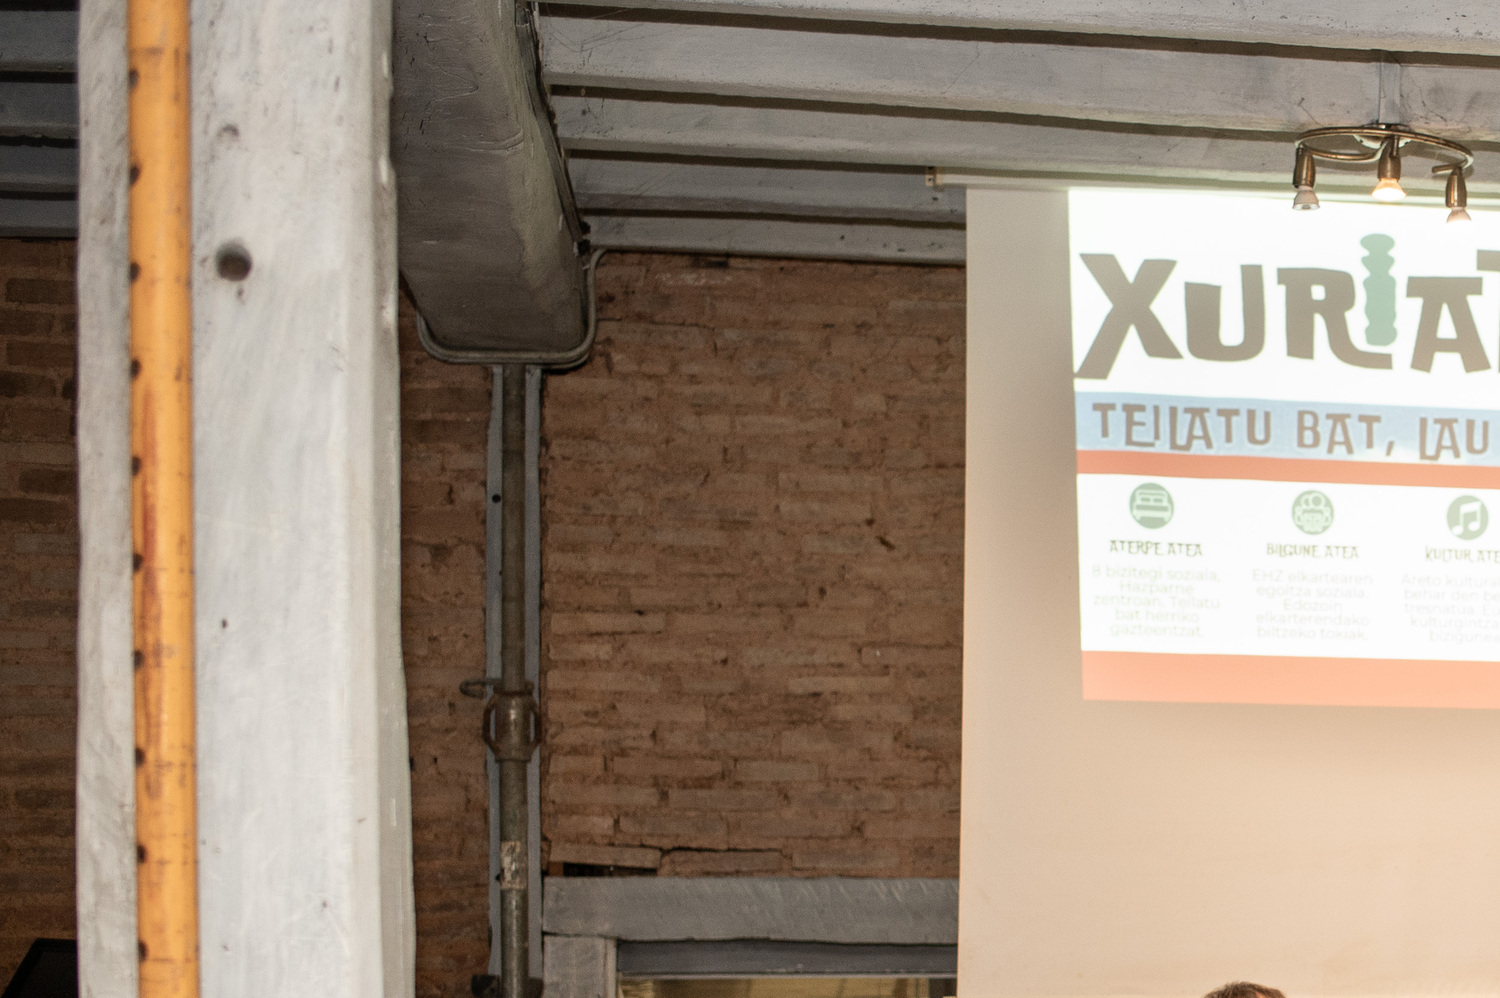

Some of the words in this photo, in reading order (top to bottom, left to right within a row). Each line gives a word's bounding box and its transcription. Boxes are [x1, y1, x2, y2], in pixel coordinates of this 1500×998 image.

[1092, 401, 1272, 452] TEILATU
[1296, 410, 1395, 458] BAT,
[1418, 416, 1489, 460] LAU
[1109, 539, 1163, 556] ATERPE
[1168, 542, 1203, 557] ATEA
[1266, 542, 1320, 559] BILGUNE
[1325, 545, 1359, 559] ATEA
[1425, 546, 1472, 563] KULTUR
